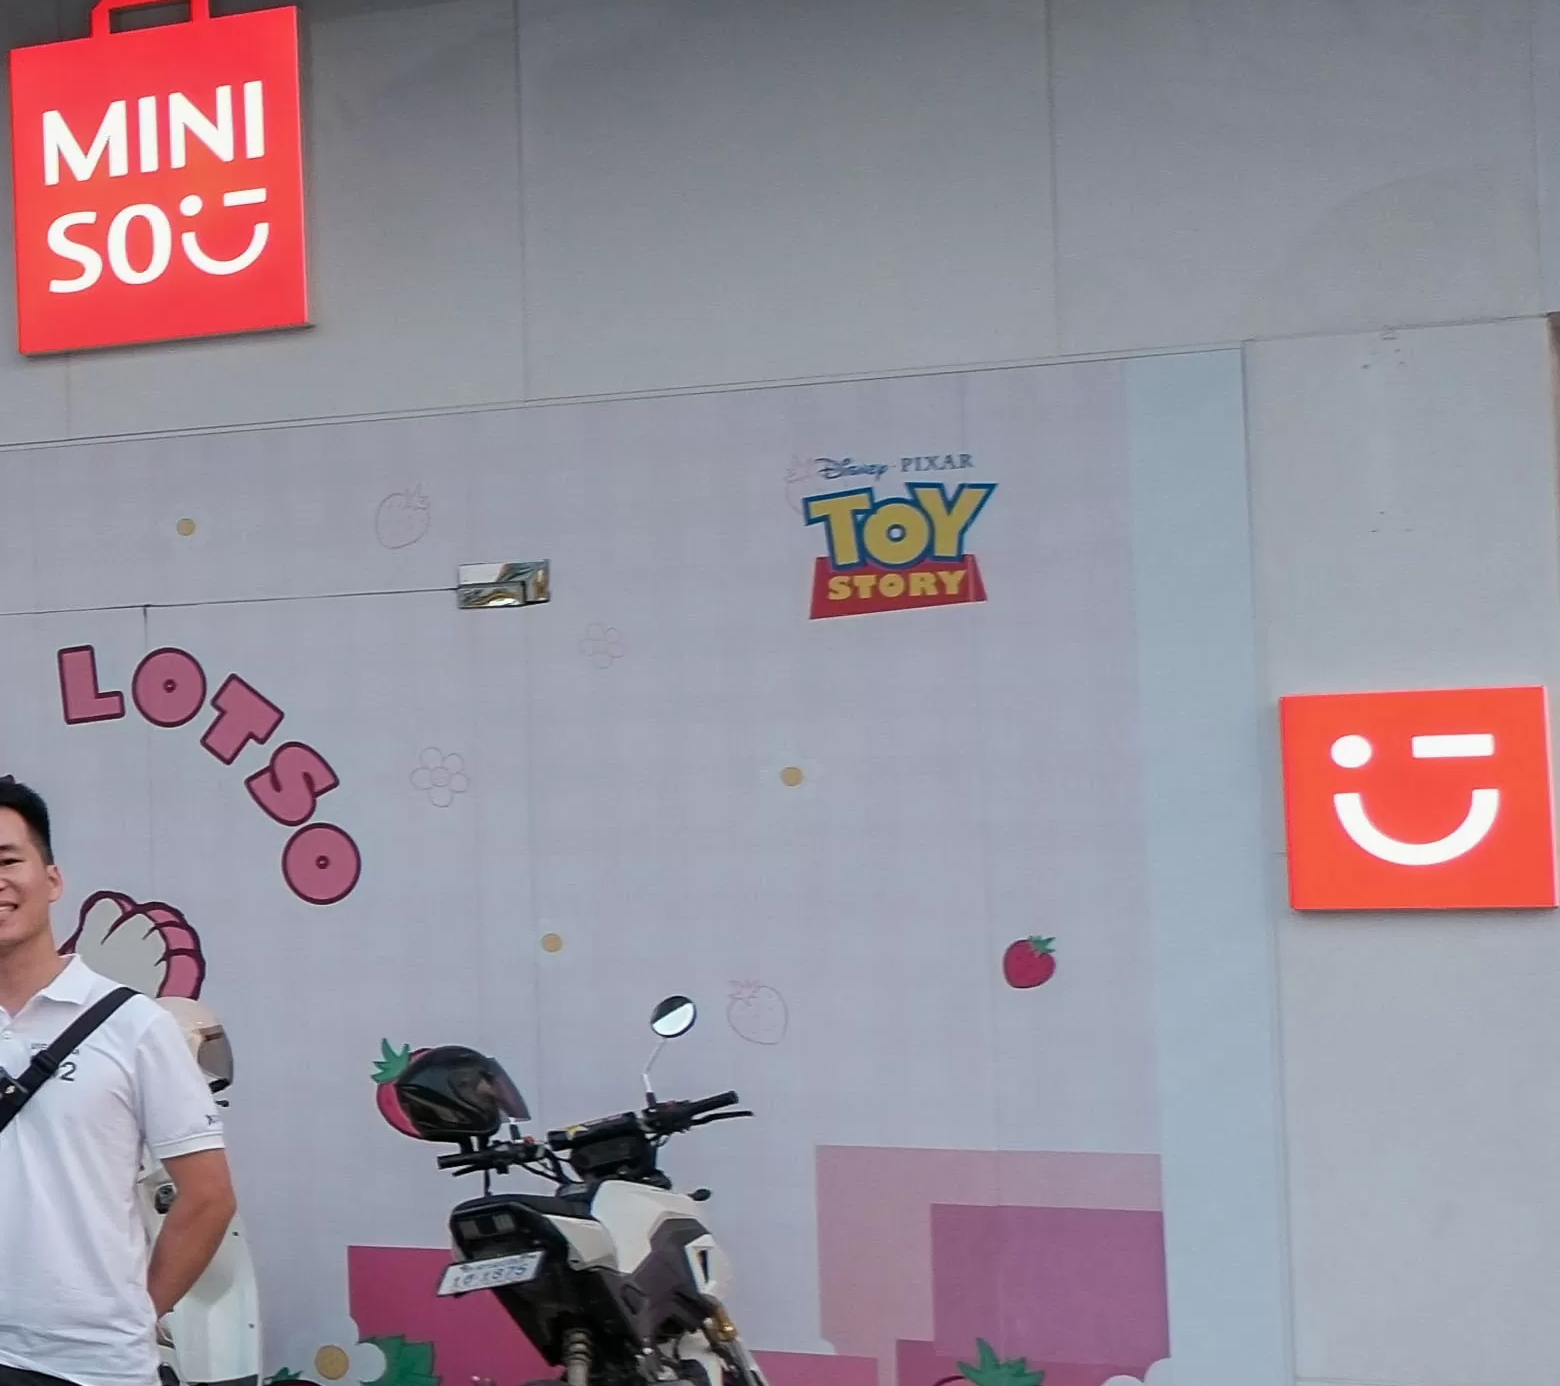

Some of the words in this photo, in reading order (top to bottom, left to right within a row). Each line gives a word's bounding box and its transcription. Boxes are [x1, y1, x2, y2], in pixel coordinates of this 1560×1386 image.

[41, 79, 266, 187] MINI
[900, 453, 976, 473] PIXAR
[802, 481, 999, 573] TOY
[826, 569, 969, 601] STORY
[57, 644, 362, 906] LOTSO
